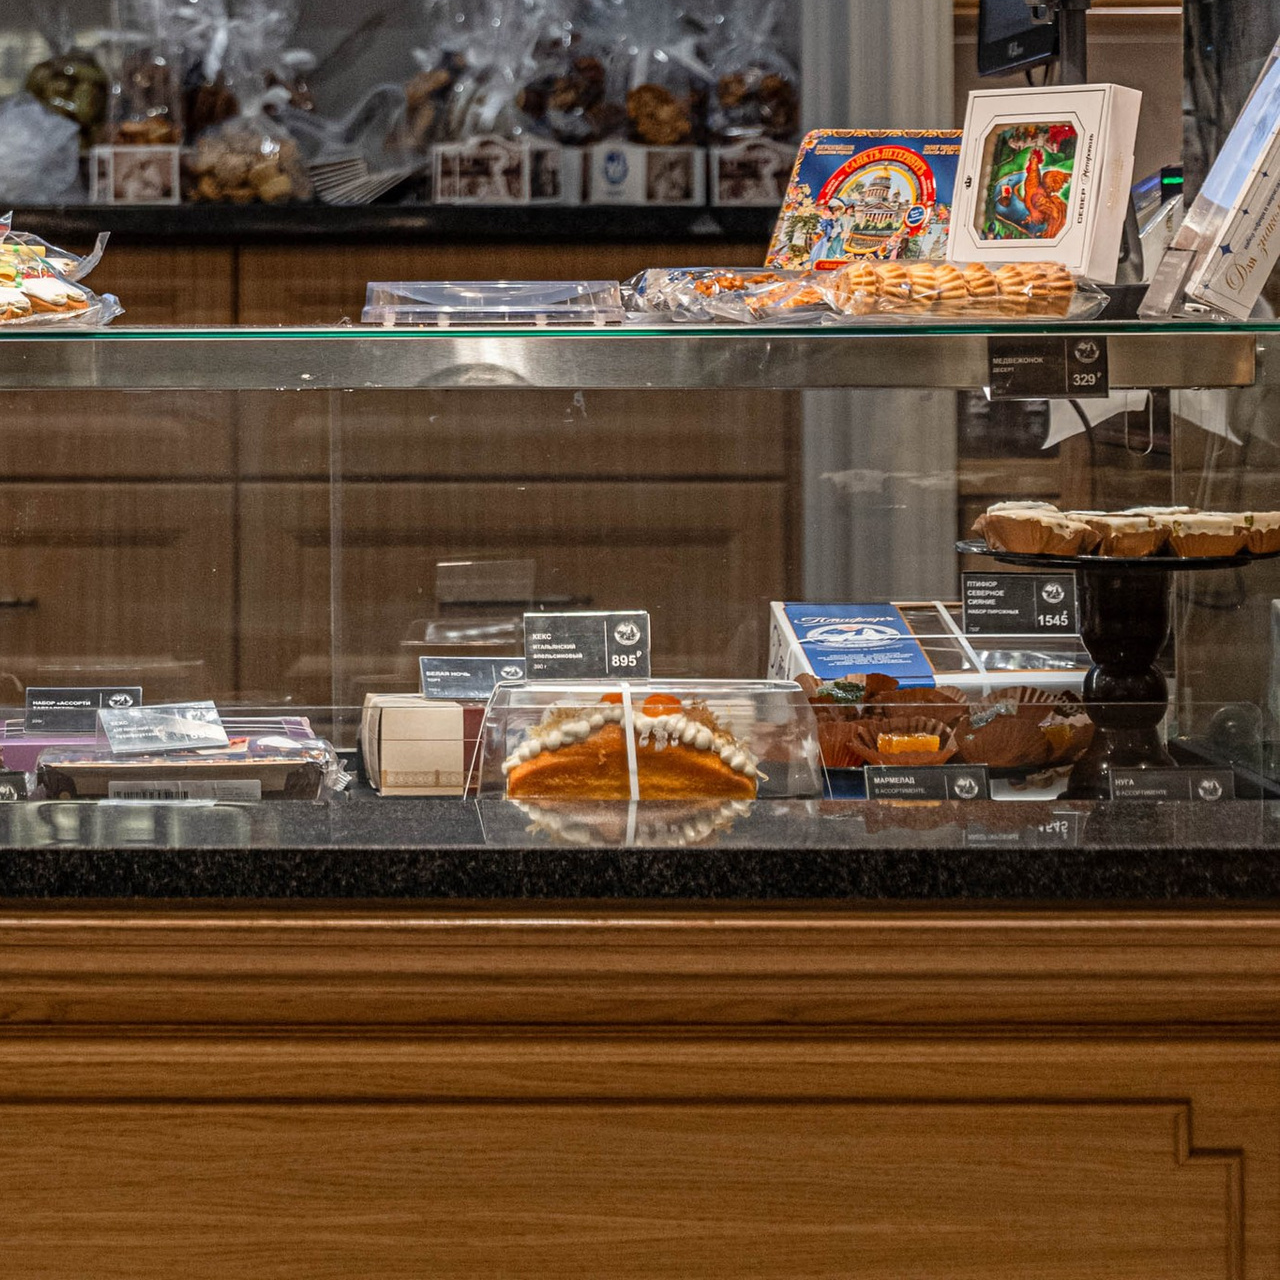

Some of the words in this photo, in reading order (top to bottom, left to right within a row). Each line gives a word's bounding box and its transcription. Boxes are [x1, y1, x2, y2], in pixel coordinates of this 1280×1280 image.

[1077, 187, 1086, 224] СЕВЕР
[1073, 374, 1096, 386] 329
[1038, 615, 1069, 626] 1545
[611, 655, 637, 667] 895
